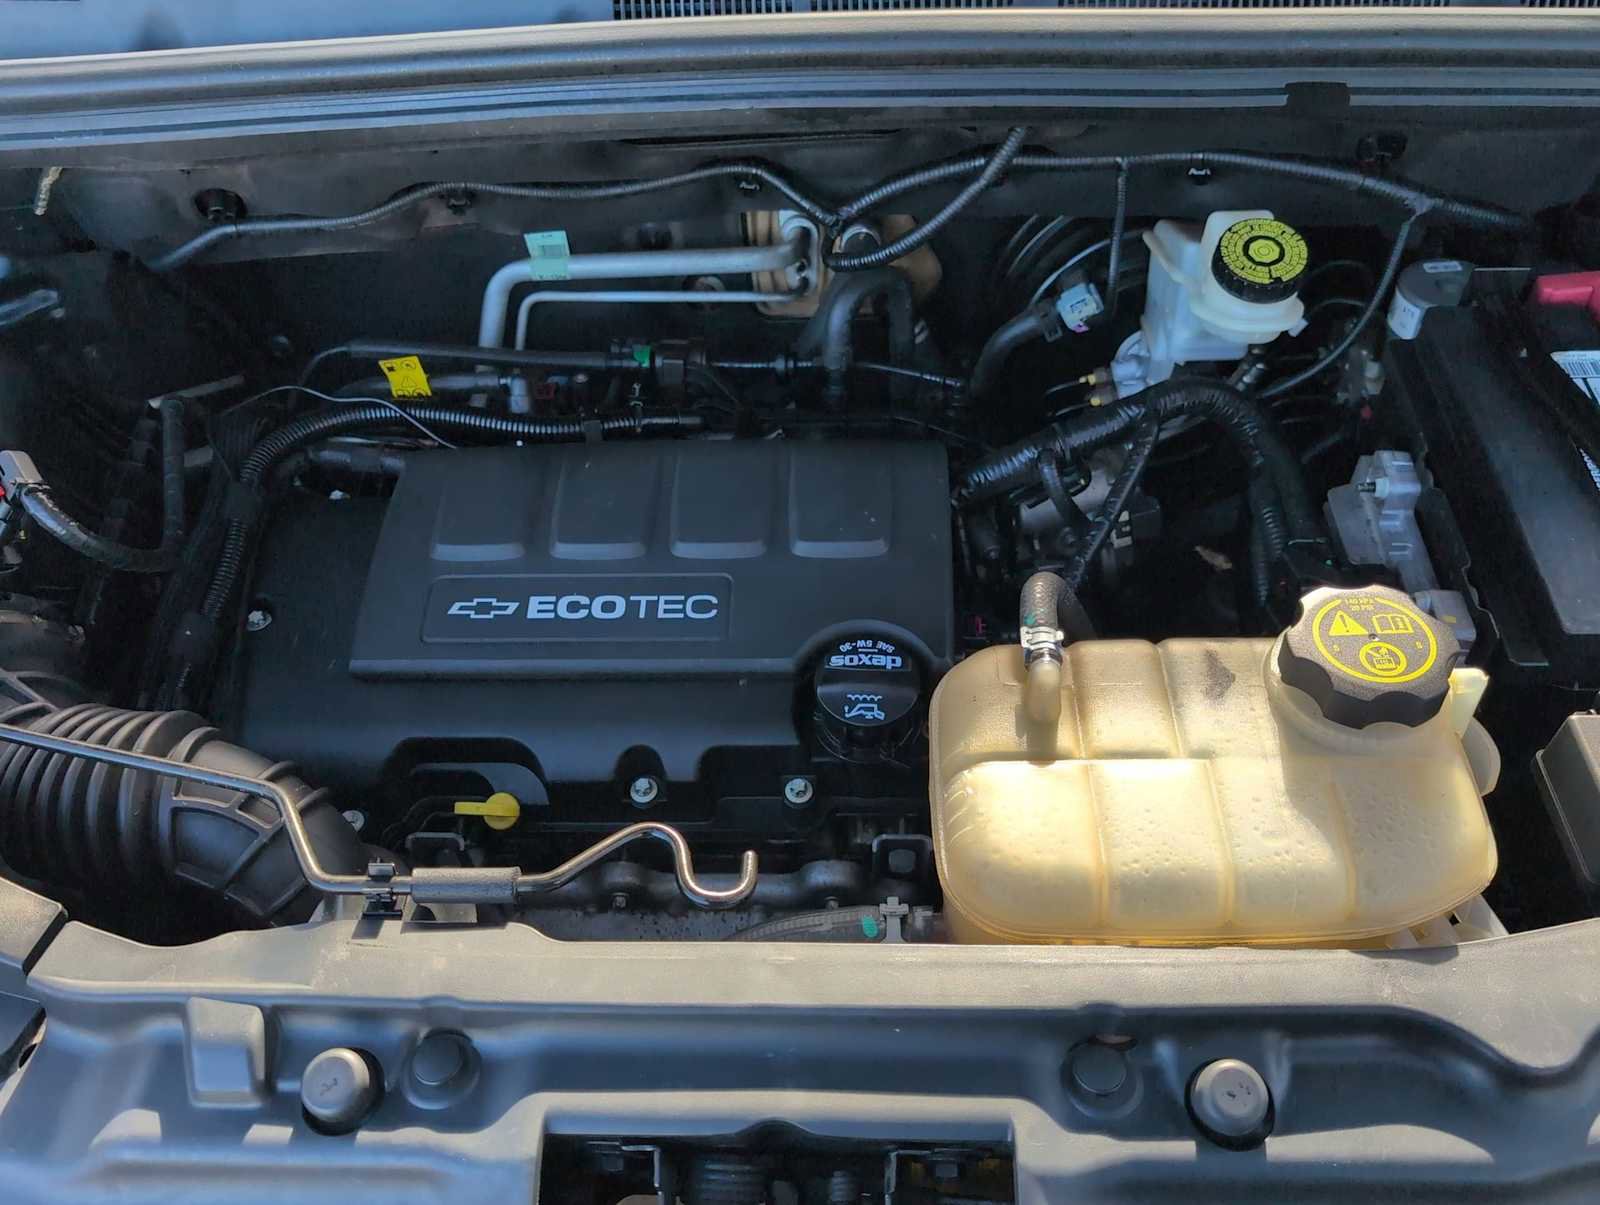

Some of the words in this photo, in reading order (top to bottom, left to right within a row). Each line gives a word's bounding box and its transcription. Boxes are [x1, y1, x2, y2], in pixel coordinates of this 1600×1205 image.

[526, 595, 719, 619] ECOTEC
[839, 640, 873, 653] 5W-30
[876, 640, 895, 653] SAE
[829, 653, 902, 669] dexos
